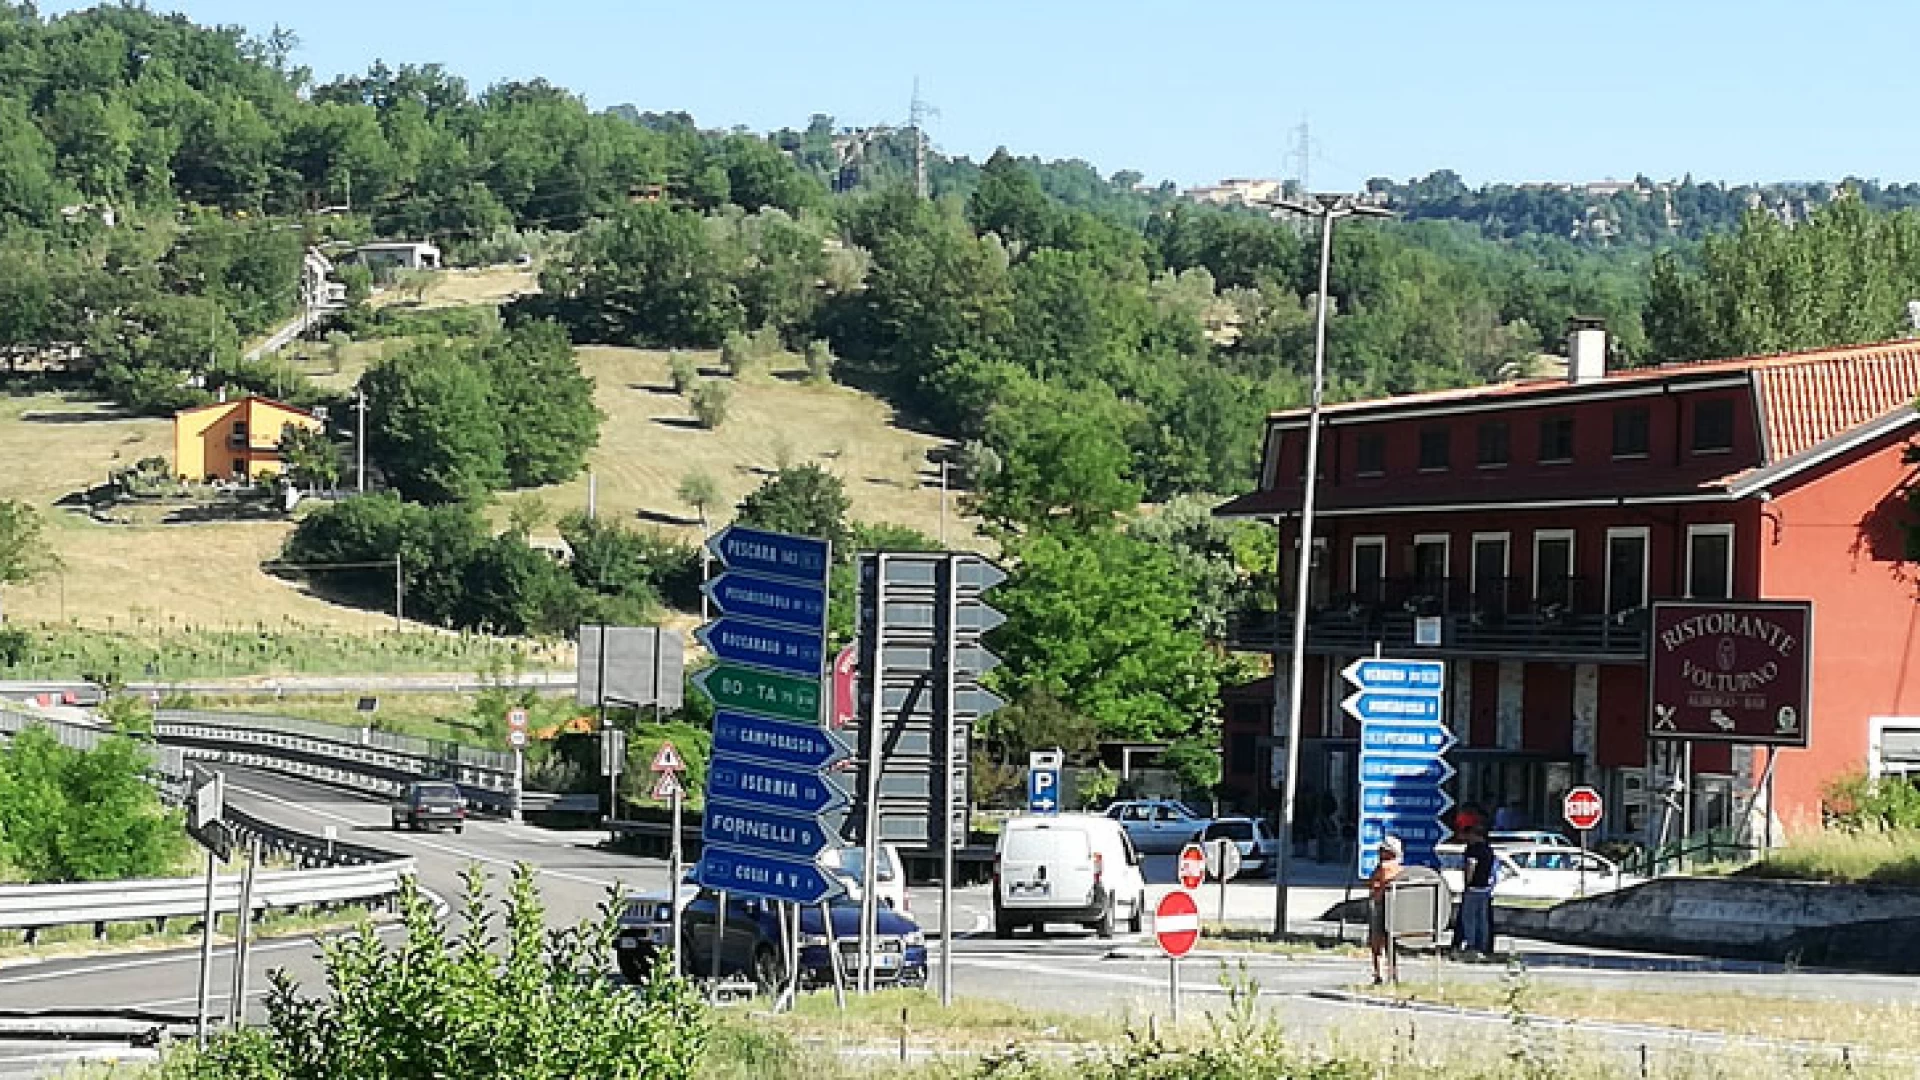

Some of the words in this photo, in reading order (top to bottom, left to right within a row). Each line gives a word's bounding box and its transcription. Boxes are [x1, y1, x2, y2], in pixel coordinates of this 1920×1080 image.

[727, 540, 777, 562] PESCARA
[1661, 612, 1797, 657] RISTORANTE
[1682, 659, 1778, 692] VOLTURNO
[757, 683, 777, 703] TA
[741, 728, 814, 754] CAMPOBASSO
[740, 772, 798, 800] ISERNIA
[1035, 772, 1054, 795] P
[1567, 801, 1601, 817] STOP
[711, 813, 796, 844] FORNELLI
[735, 864, 770, 883] COLLI
[775, 870, 785, 886] A
[1179, 859, 1205, 877] STOP
